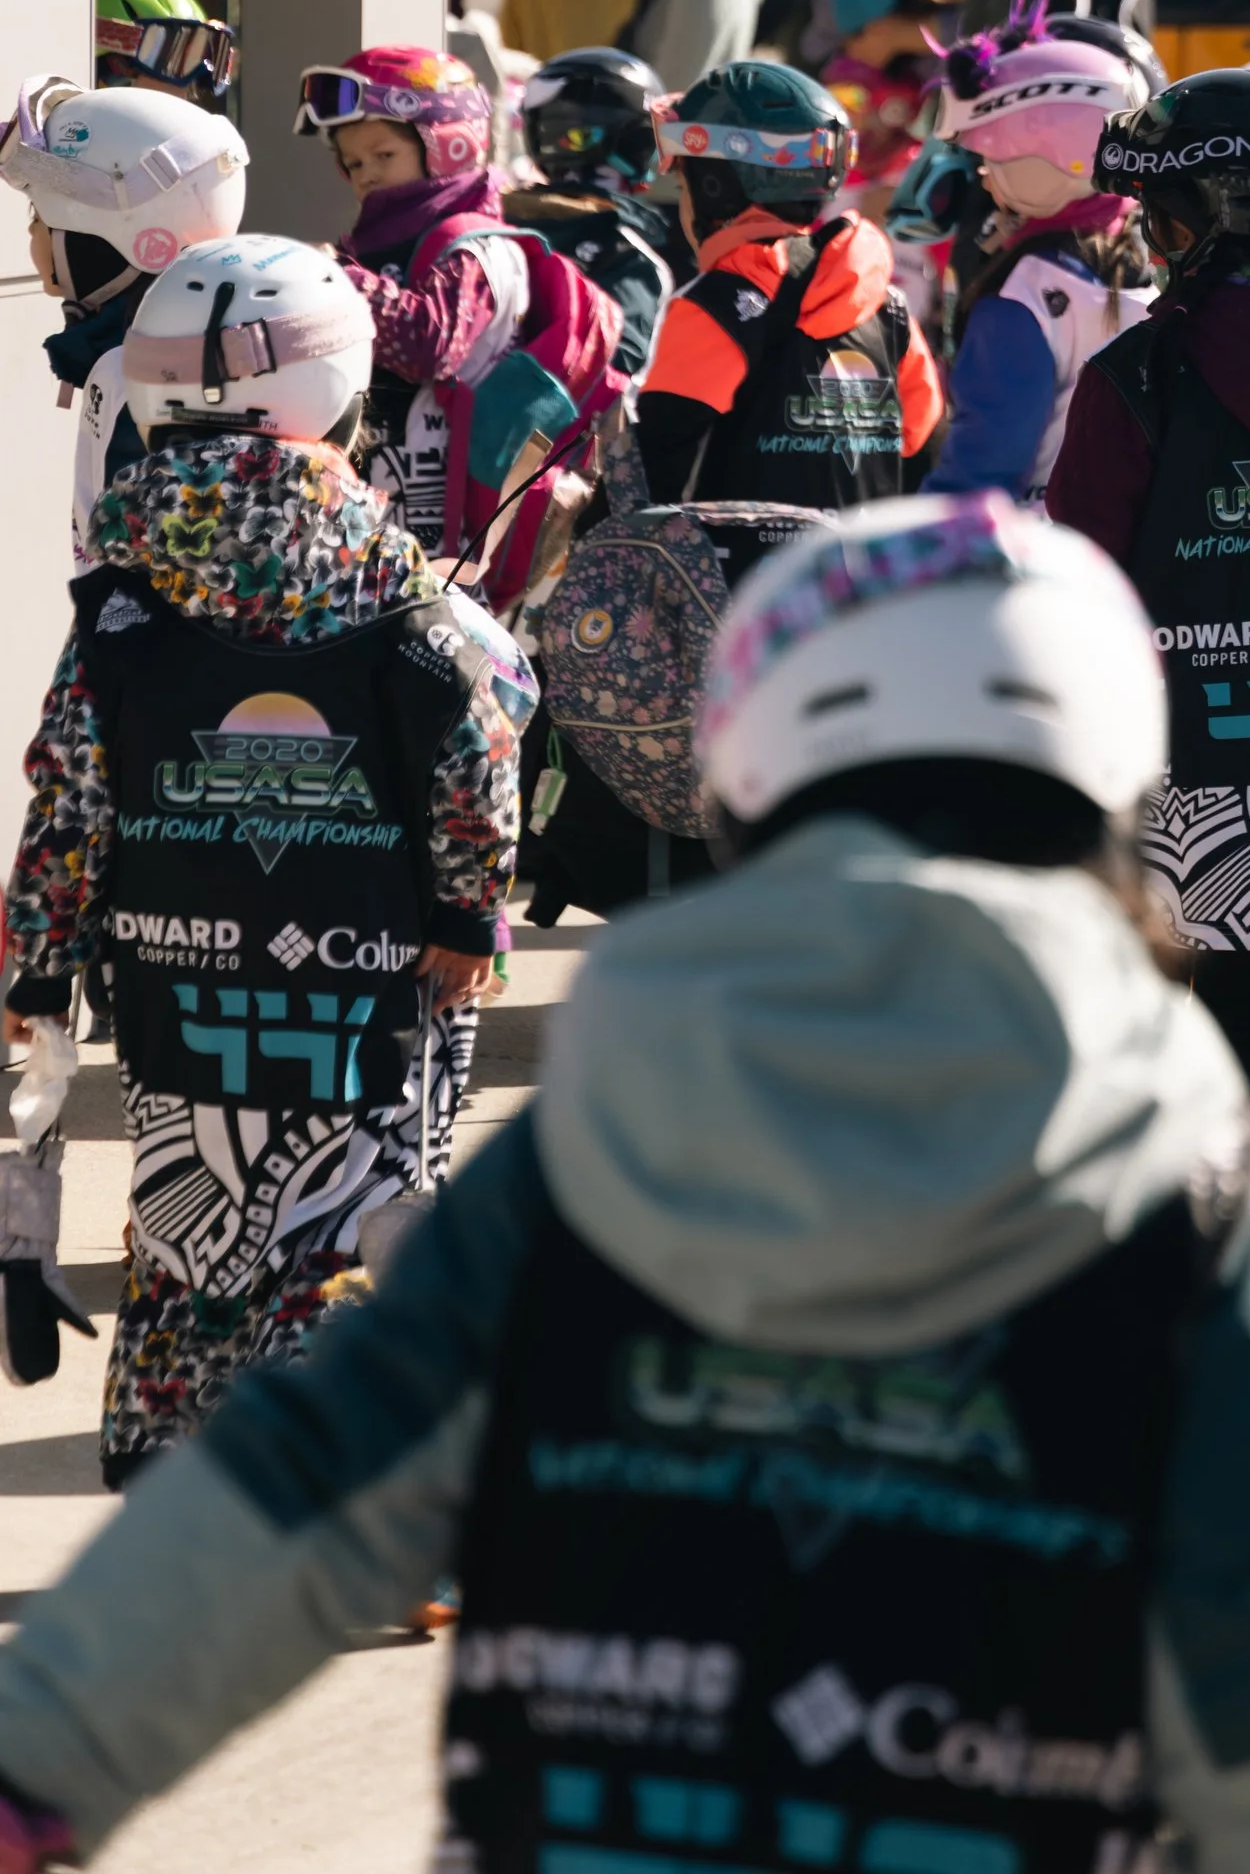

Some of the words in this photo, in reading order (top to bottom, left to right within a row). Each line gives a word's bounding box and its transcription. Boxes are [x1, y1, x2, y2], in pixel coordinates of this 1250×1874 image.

[969, 81, 1111, 120] SCOTT
[1191, 650, 1248, 667] COPPER
[225, 737, 323, 763] 2020
[158, 763, 375, 814] USASA
[116, 811, 225, 843] NATIONAL
[232, 817, 404, 851] CHAMPIONSHIP
[137, 945, 197, 968] COPPER
[216, 952, 241, 971] CO
